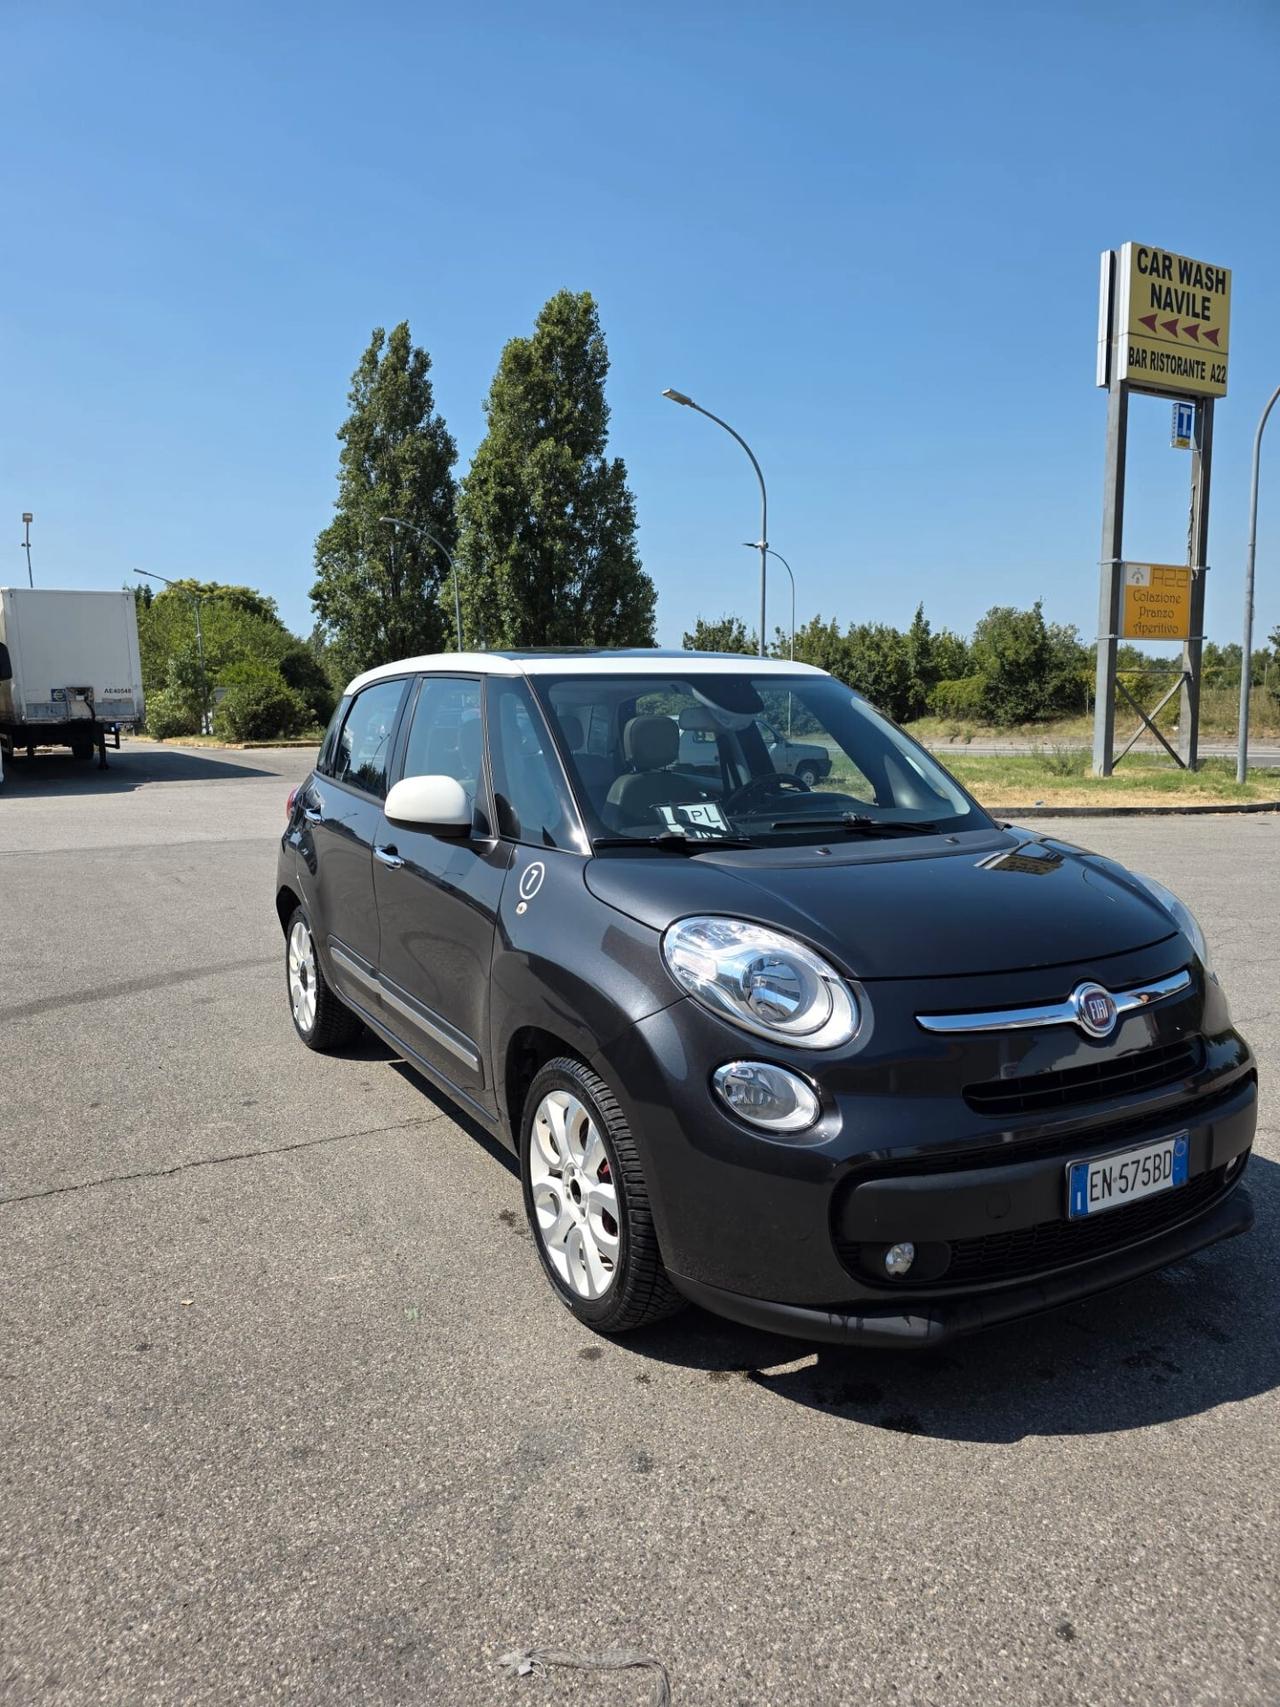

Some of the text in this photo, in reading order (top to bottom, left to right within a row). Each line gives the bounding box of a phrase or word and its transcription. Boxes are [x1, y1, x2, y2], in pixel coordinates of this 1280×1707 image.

[1137, 248, 1226, 295] CAR WASH
[1150, 283, 1211, 321] NAVILE
[1128, 347, 1226, 384] BAR RISTORANTE A22
[1133, 589, 1182, 604] Colazione
[1138, 607, 1175, 620] Pranzo
[1133, 622, 1179, 635] Aperitivo
[1088, 999, 1108, 1020] FIAT
